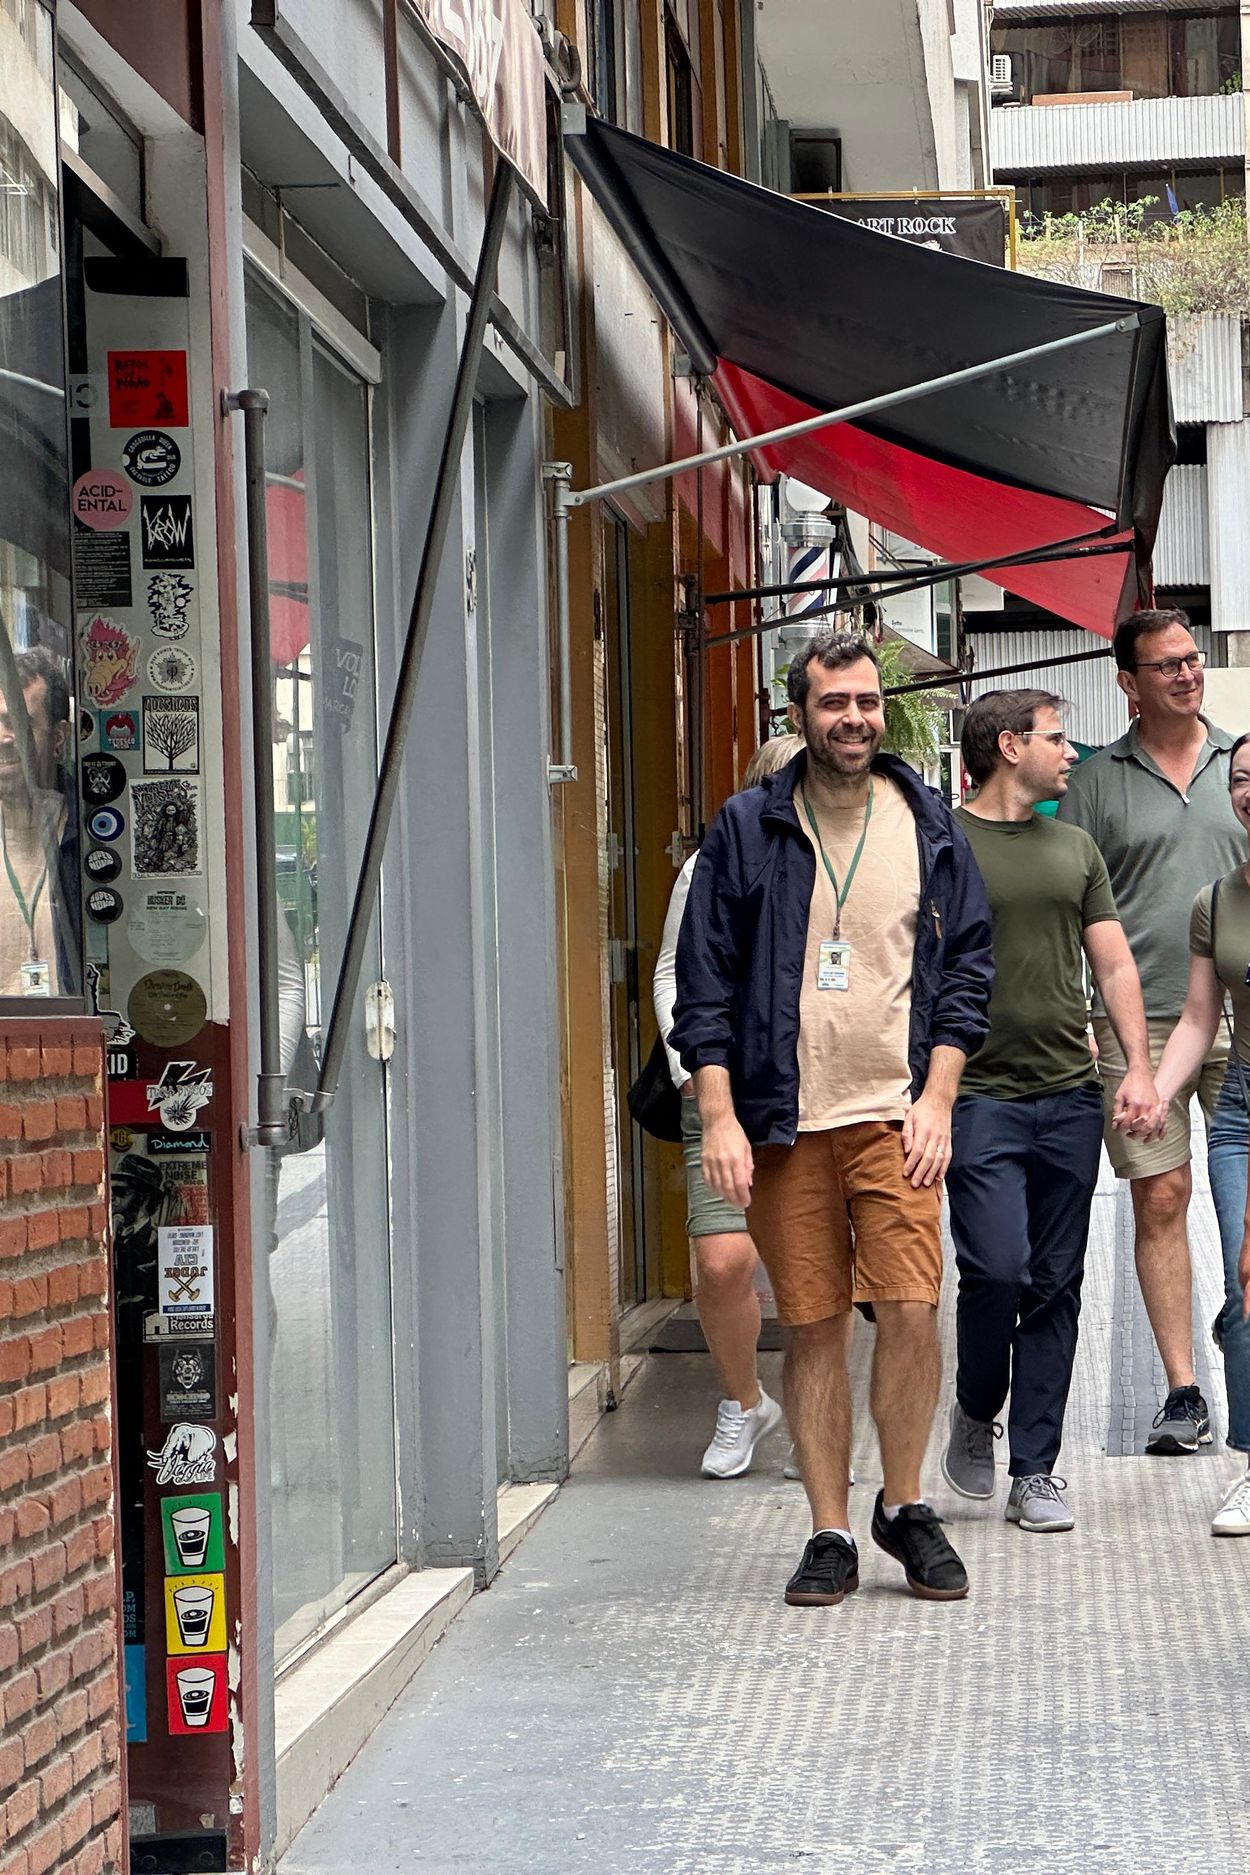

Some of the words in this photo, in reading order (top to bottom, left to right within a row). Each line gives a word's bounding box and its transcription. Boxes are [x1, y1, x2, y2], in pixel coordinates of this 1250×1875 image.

[898, 217, 956, 234] ROCK
[79, 485, 123, 498] ACID-
[78, 499, 127, 512] ENTAL
[144, 697, 198, 711] QUESTIONS
[151, 1133, 209, 1149] Diamond
[165, 1170, 197, 1180] NOISE
[164, 1267, 208, 1278] JUDGE
[171, 1318, 214, 1330] Records
